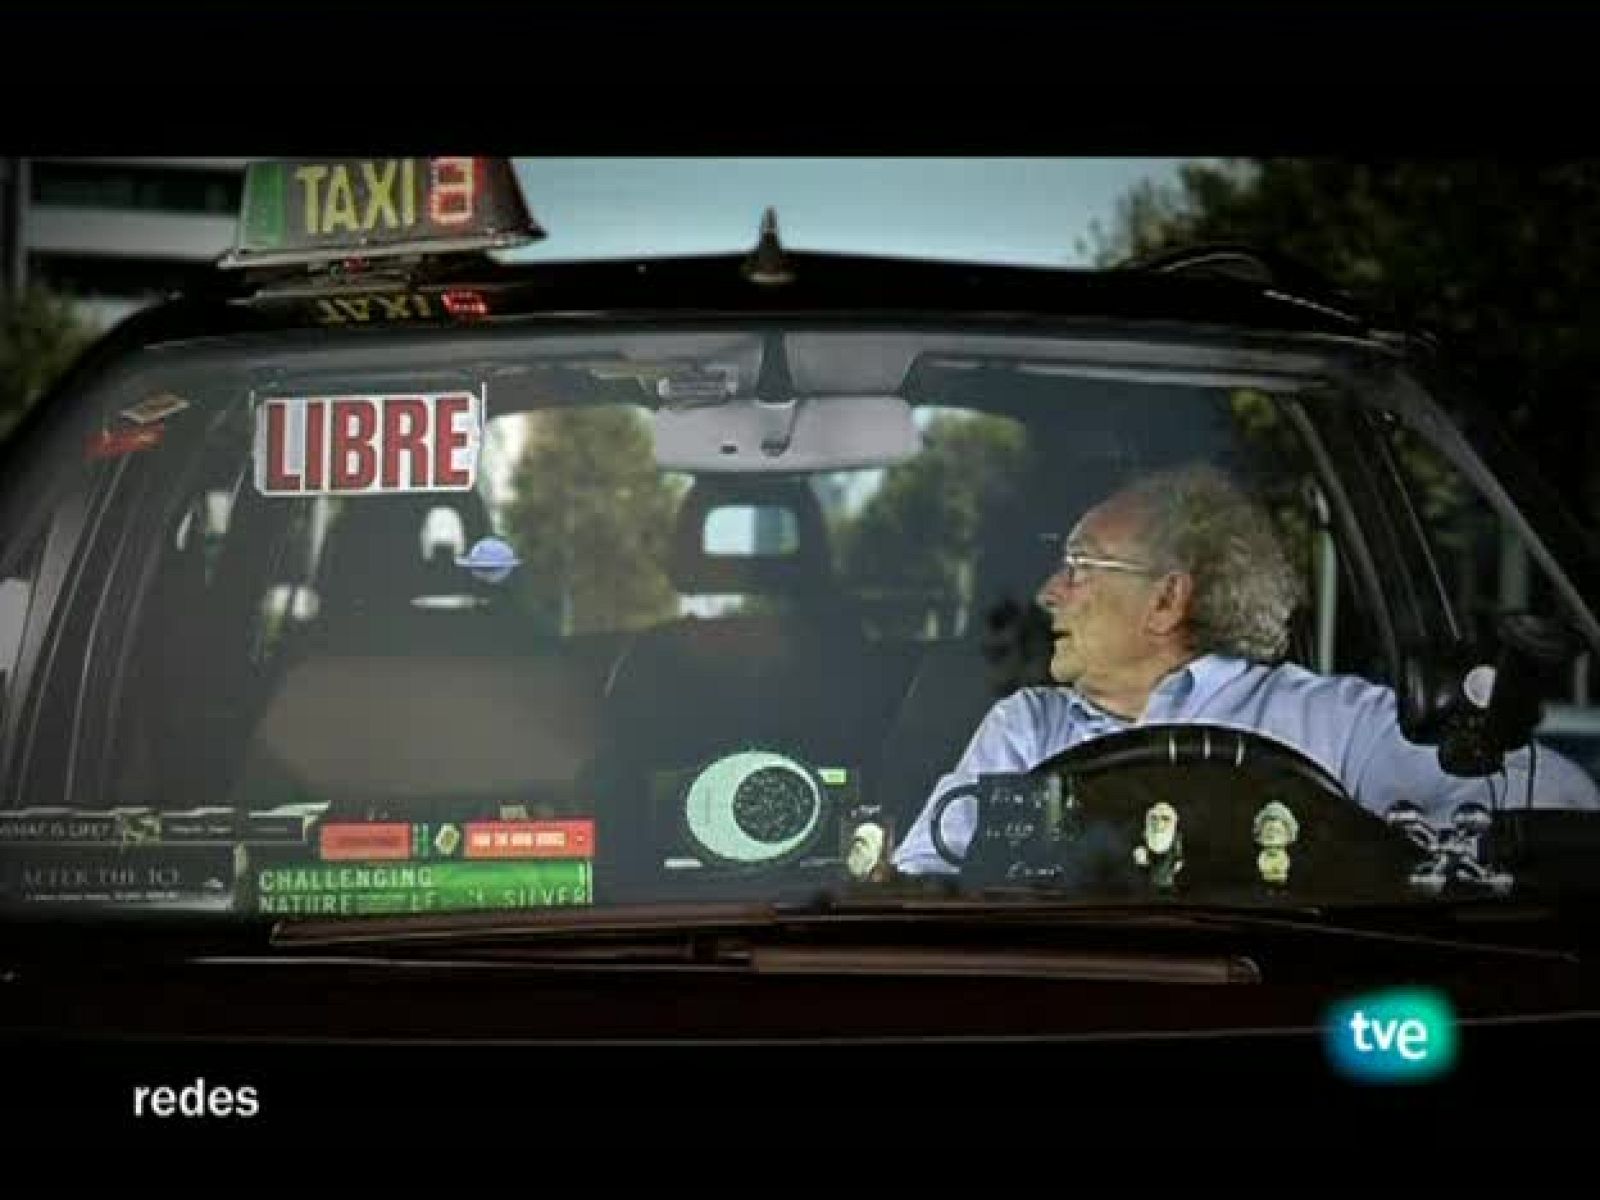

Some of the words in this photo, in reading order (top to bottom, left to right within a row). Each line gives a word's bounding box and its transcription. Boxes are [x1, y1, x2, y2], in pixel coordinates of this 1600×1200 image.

[296, 158, 417, 234] TAXI
[265, 397, 473, 492] LIBRE
[258, 867, 432, 893] CHALLENGING
[258, 893, 356, 915] NATURE
